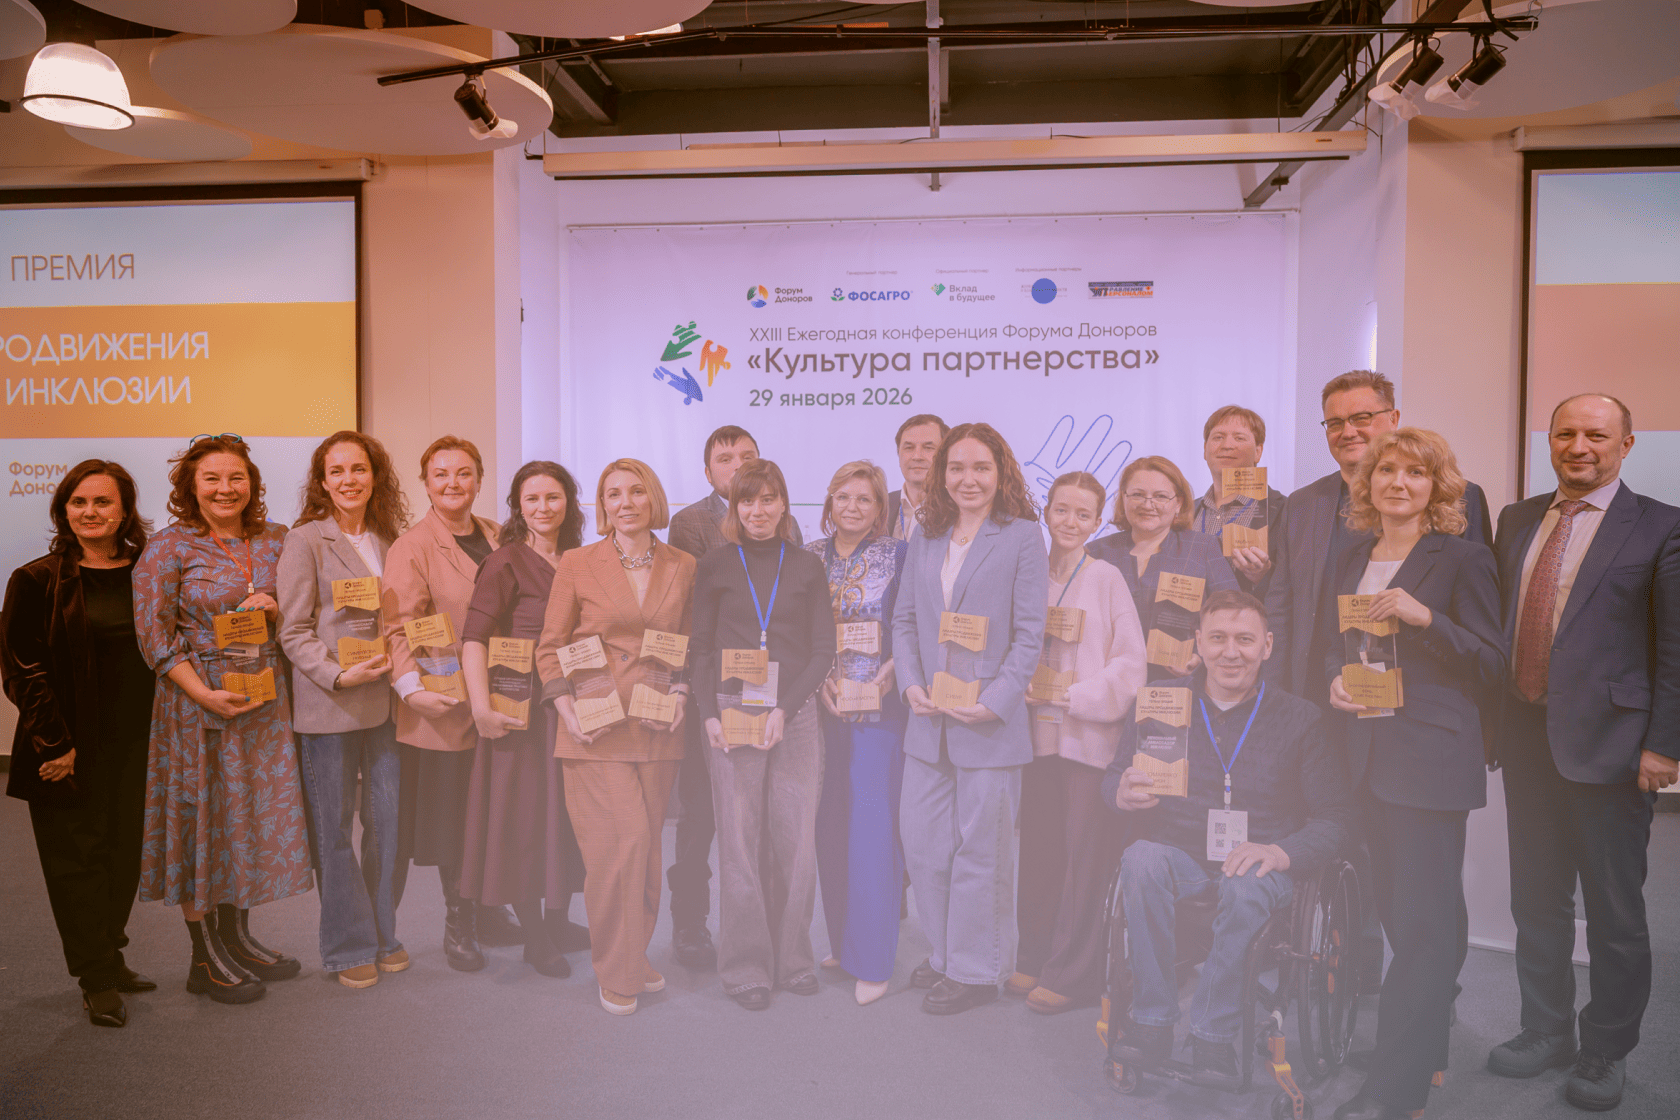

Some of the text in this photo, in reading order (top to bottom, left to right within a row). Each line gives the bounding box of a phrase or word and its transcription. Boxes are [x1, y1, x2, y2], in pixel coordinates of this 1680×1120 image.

[11, 254, 135, 281] ПРЕМИЯ
[774, 287, 803, 296] Форум
[847, 290, 911, 302] ФОСАГРО
[949, 285, 978, 293] Вклад
[956, 293, 996, 303] будущее
[774, 295, 813, 303] Доноров
[749, 322, 1158, 343] XXIII Ежегодная конференция Форума Доноров
[0, 332, 209, 365] ОДВИЖЕНИЯ
[747, 347, 1160, 380] «Культура партнерства»
[6, 376, 191, 405] ИНКЛЮЗИИ
[749, 387, 913, 410] 29 января 2026
[9, 461, 68, 479] Форум
[9, 479, 60, 497] Доно
